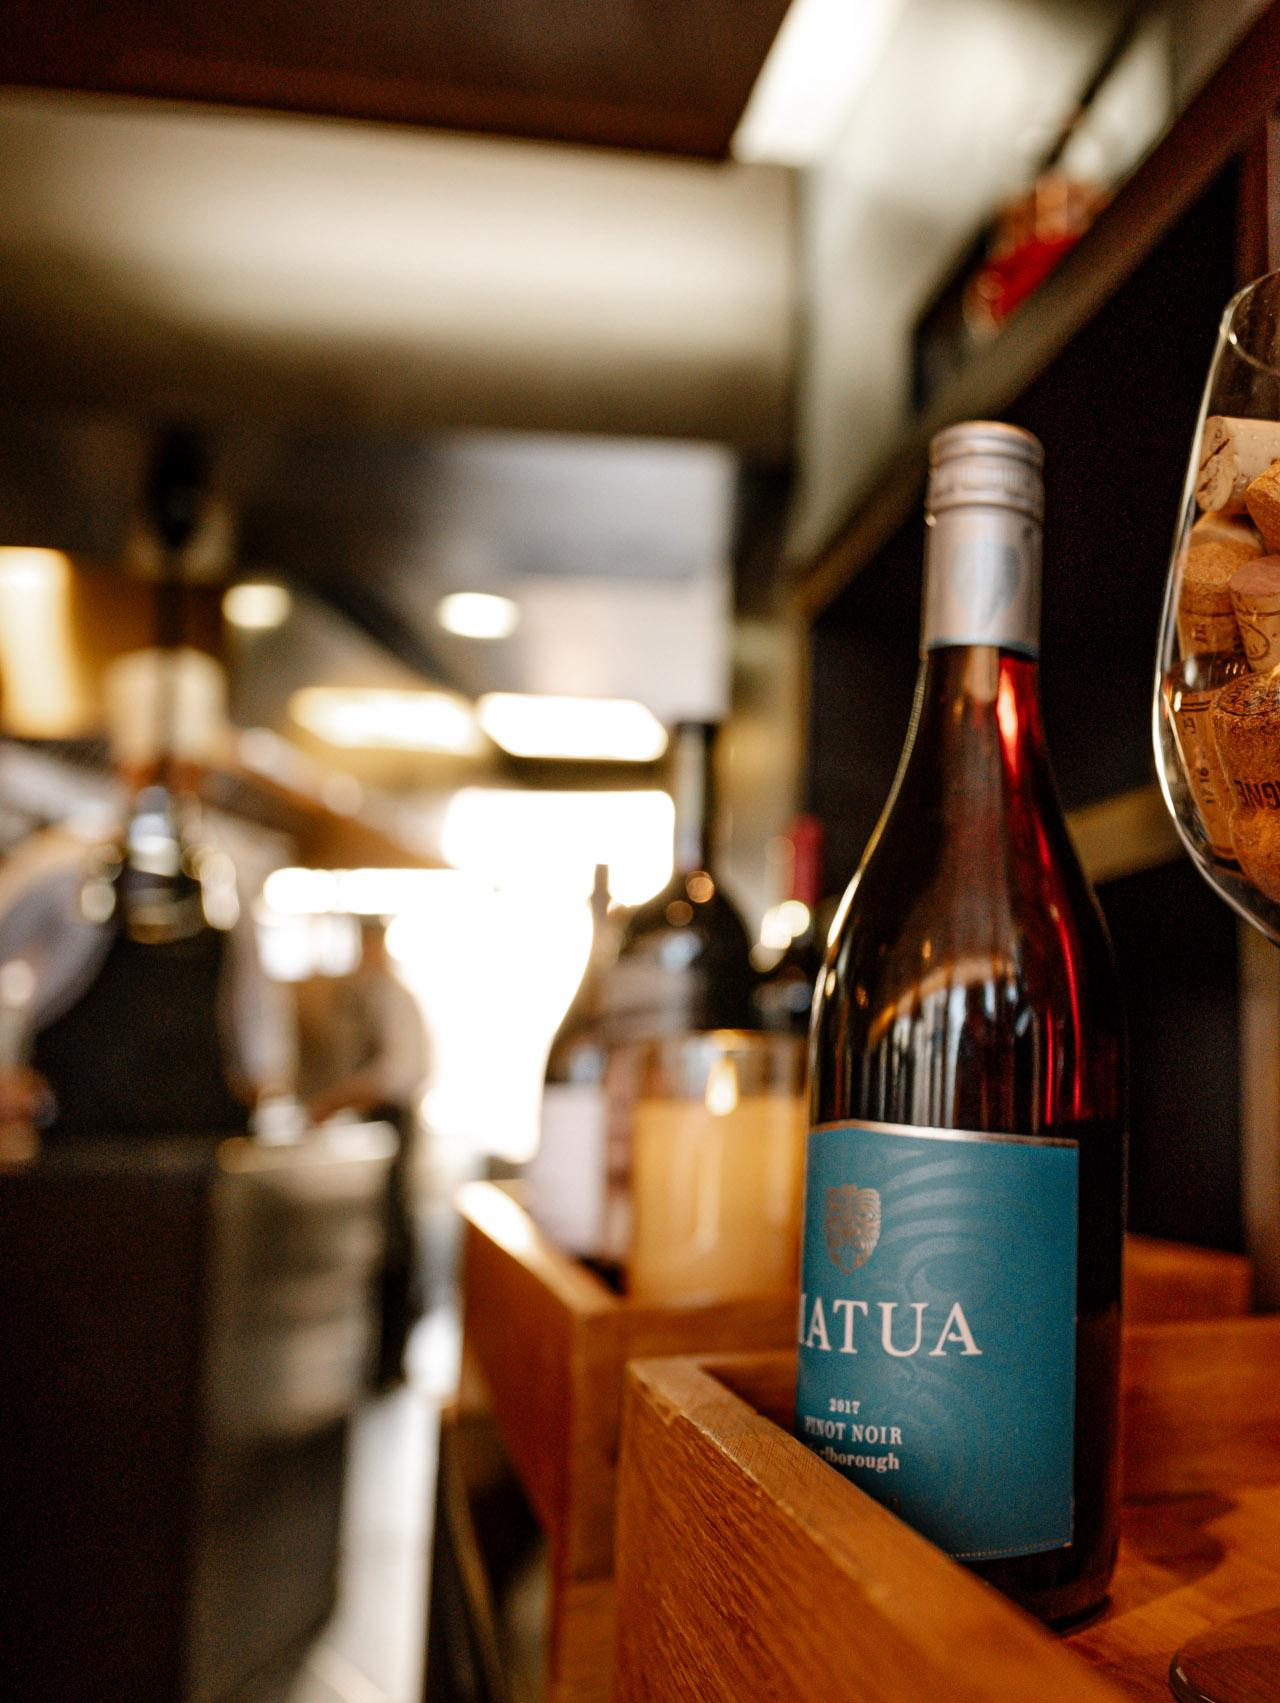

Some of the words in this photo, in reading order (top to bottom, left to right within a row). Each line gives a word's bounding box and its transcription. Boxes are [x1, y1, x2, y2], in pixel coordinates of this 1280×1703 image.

[828, 1398, 861, 1414] 2017
[803, 1415, 847, 1441] PINOT
[851, 1423, 903, 1446] NOIR
[819, 1446, 900, 1473] lborough
